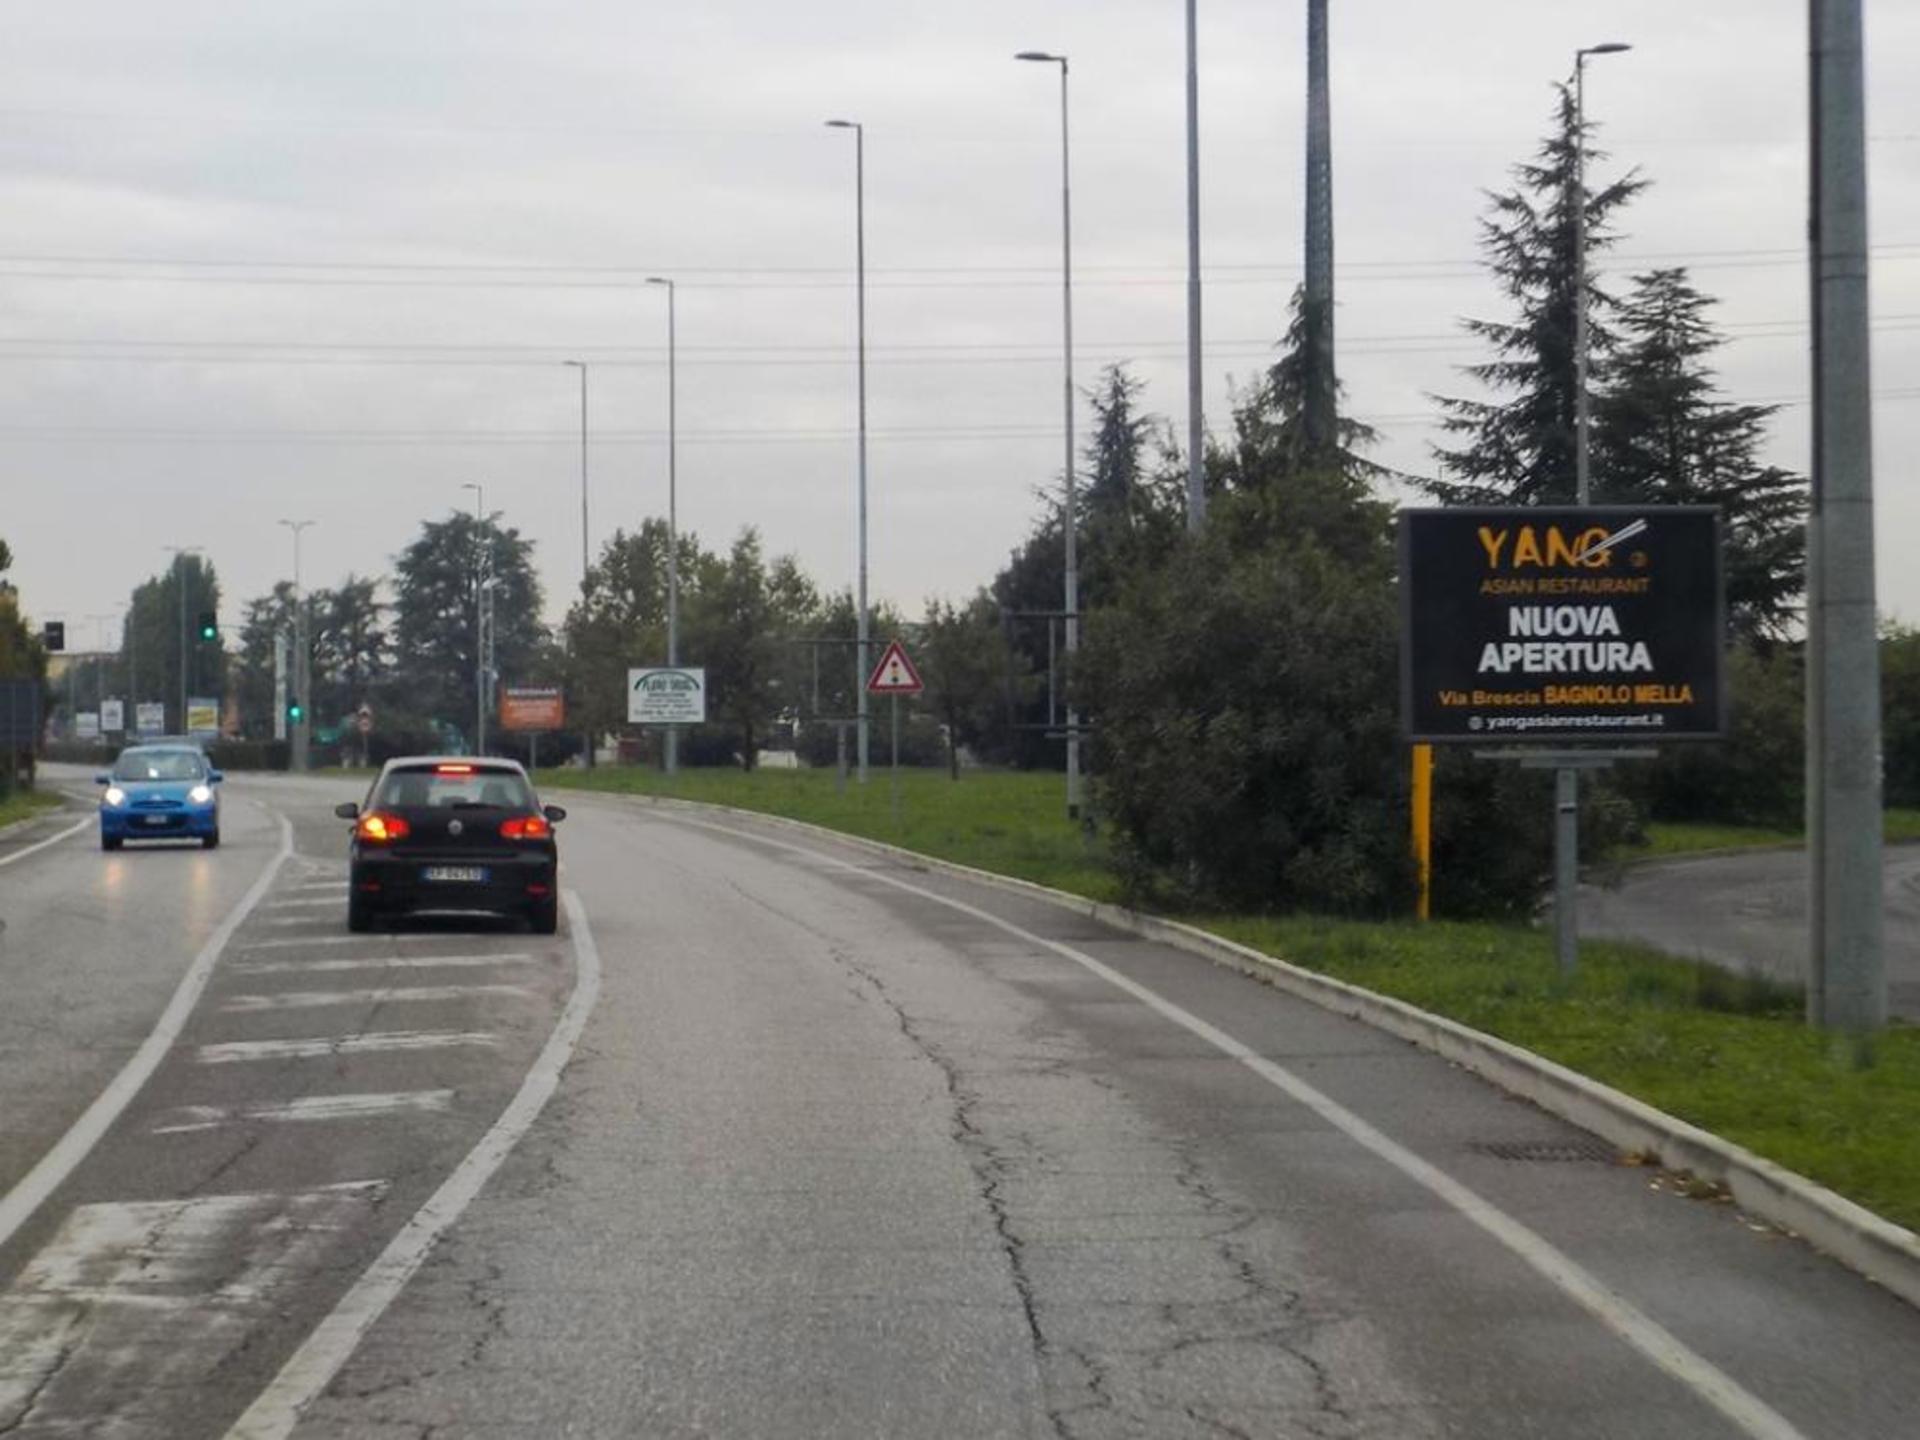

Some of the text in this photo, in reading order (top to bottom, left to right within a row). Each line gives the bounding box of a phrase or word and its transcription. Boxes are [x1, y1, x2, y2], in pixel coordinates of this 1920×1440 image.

[1477, 526, 1612, 568] YANG
[1479, 576, 1649, 594] ASIAN RESTAURANT
[1509, 605, 1621, 637] NUOVA
[1477, 642, 1654, 672] APERTURA
[1438, 690, 1468, 706] Via
[1472, 690, 1540, 705] Brescia
[1544, 685, 1632, 705] BAGNOLO
[1486, 713, 1665, 731] yangasianrestaurant.it
